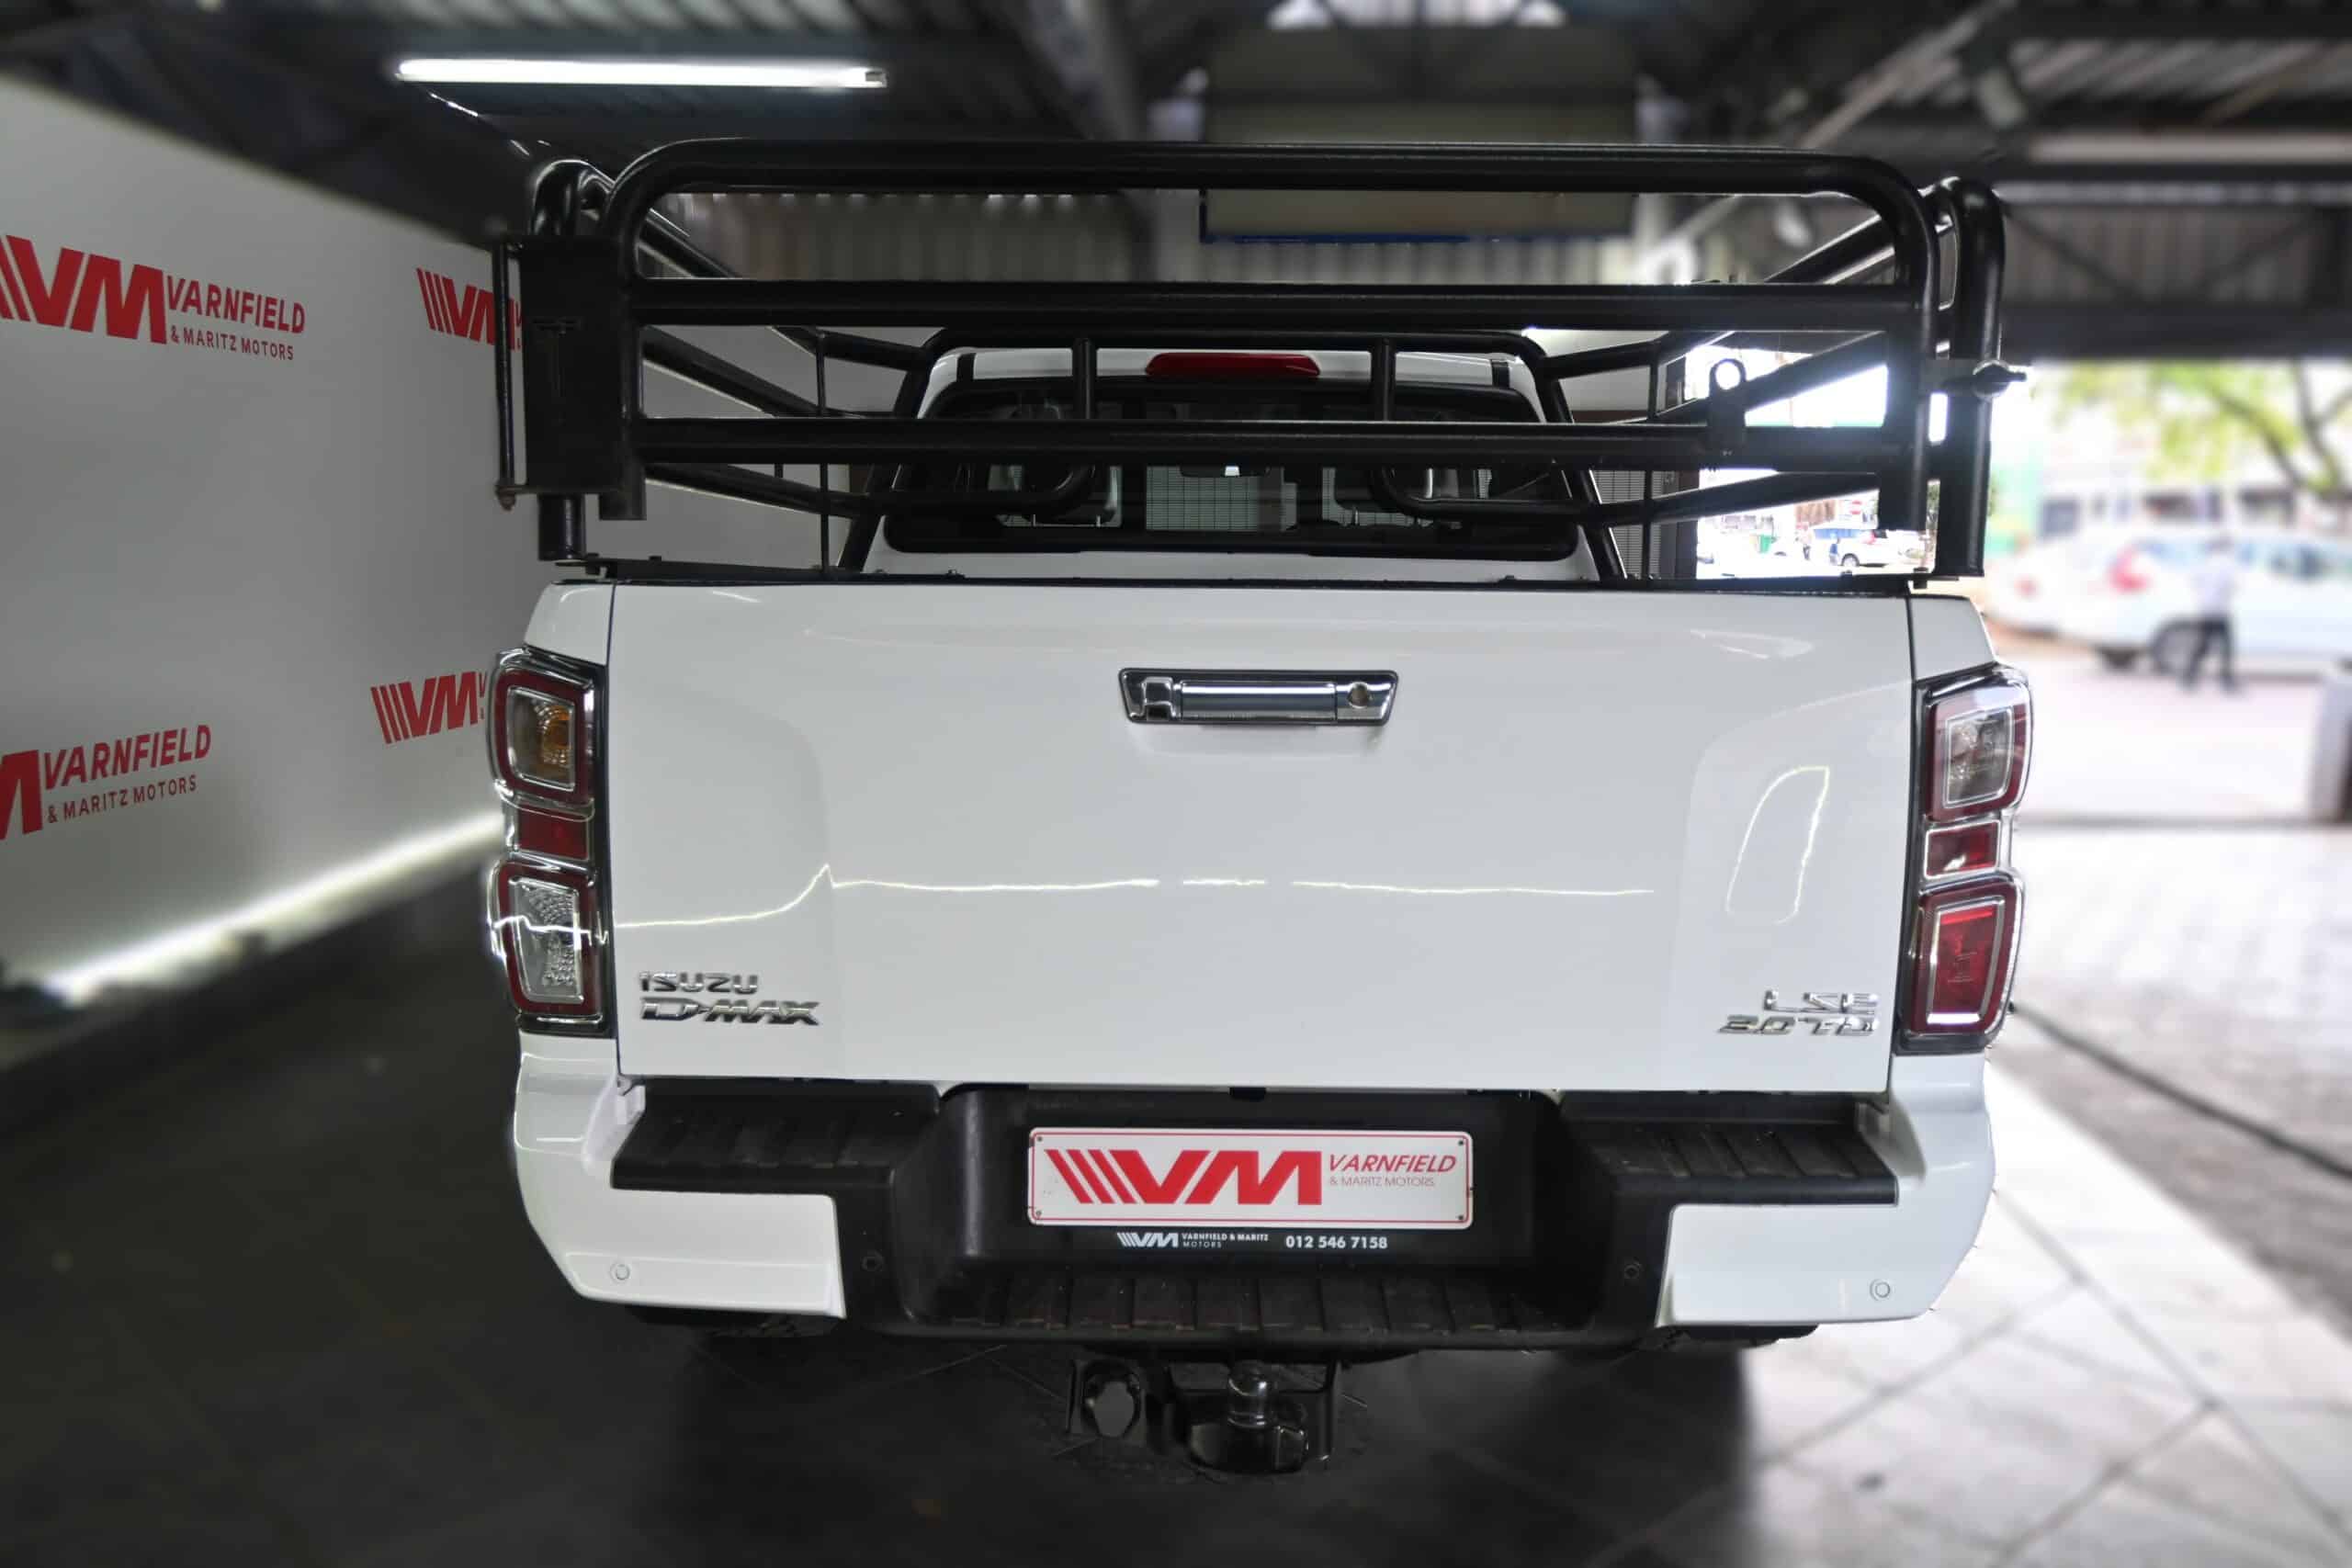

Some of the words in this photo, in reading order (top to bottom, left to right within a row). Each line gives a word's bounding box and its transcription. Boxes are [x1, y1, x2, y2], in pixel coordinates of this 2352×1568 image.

[166, 275, 306, 334] VARNFIELD
[170, 325, 180, 344] &
[184, 327, 237, 351] MARITZ
[241, 337, 294, 361] MOTORS
[44, 725, 211, 791] VARNFIELD
[48, 805, 58, 823] &
[63, 788, 129, 819] MARITZ
[133, 774, 197, 804] MOTORS
[640, 972, 759, 995] ISUZU
[1329, 1154, 1457, 1173] VARNFIELD
[1329, 1176, 1339, 1187] &
[1341, 1176, 1382, 1187] MARITZ
[1385, 1176, 1436, 1188] MOTORS
[1182, 1233, 1227, 1241] VARNFIELD
[1238, 1234, 1269, 1242] MARITZ
[1285, 1235, 1314, 1248] 012
[1317, 1235, 1346, 1248] 546
[1350, 1236, 1388, 1249] 7158
